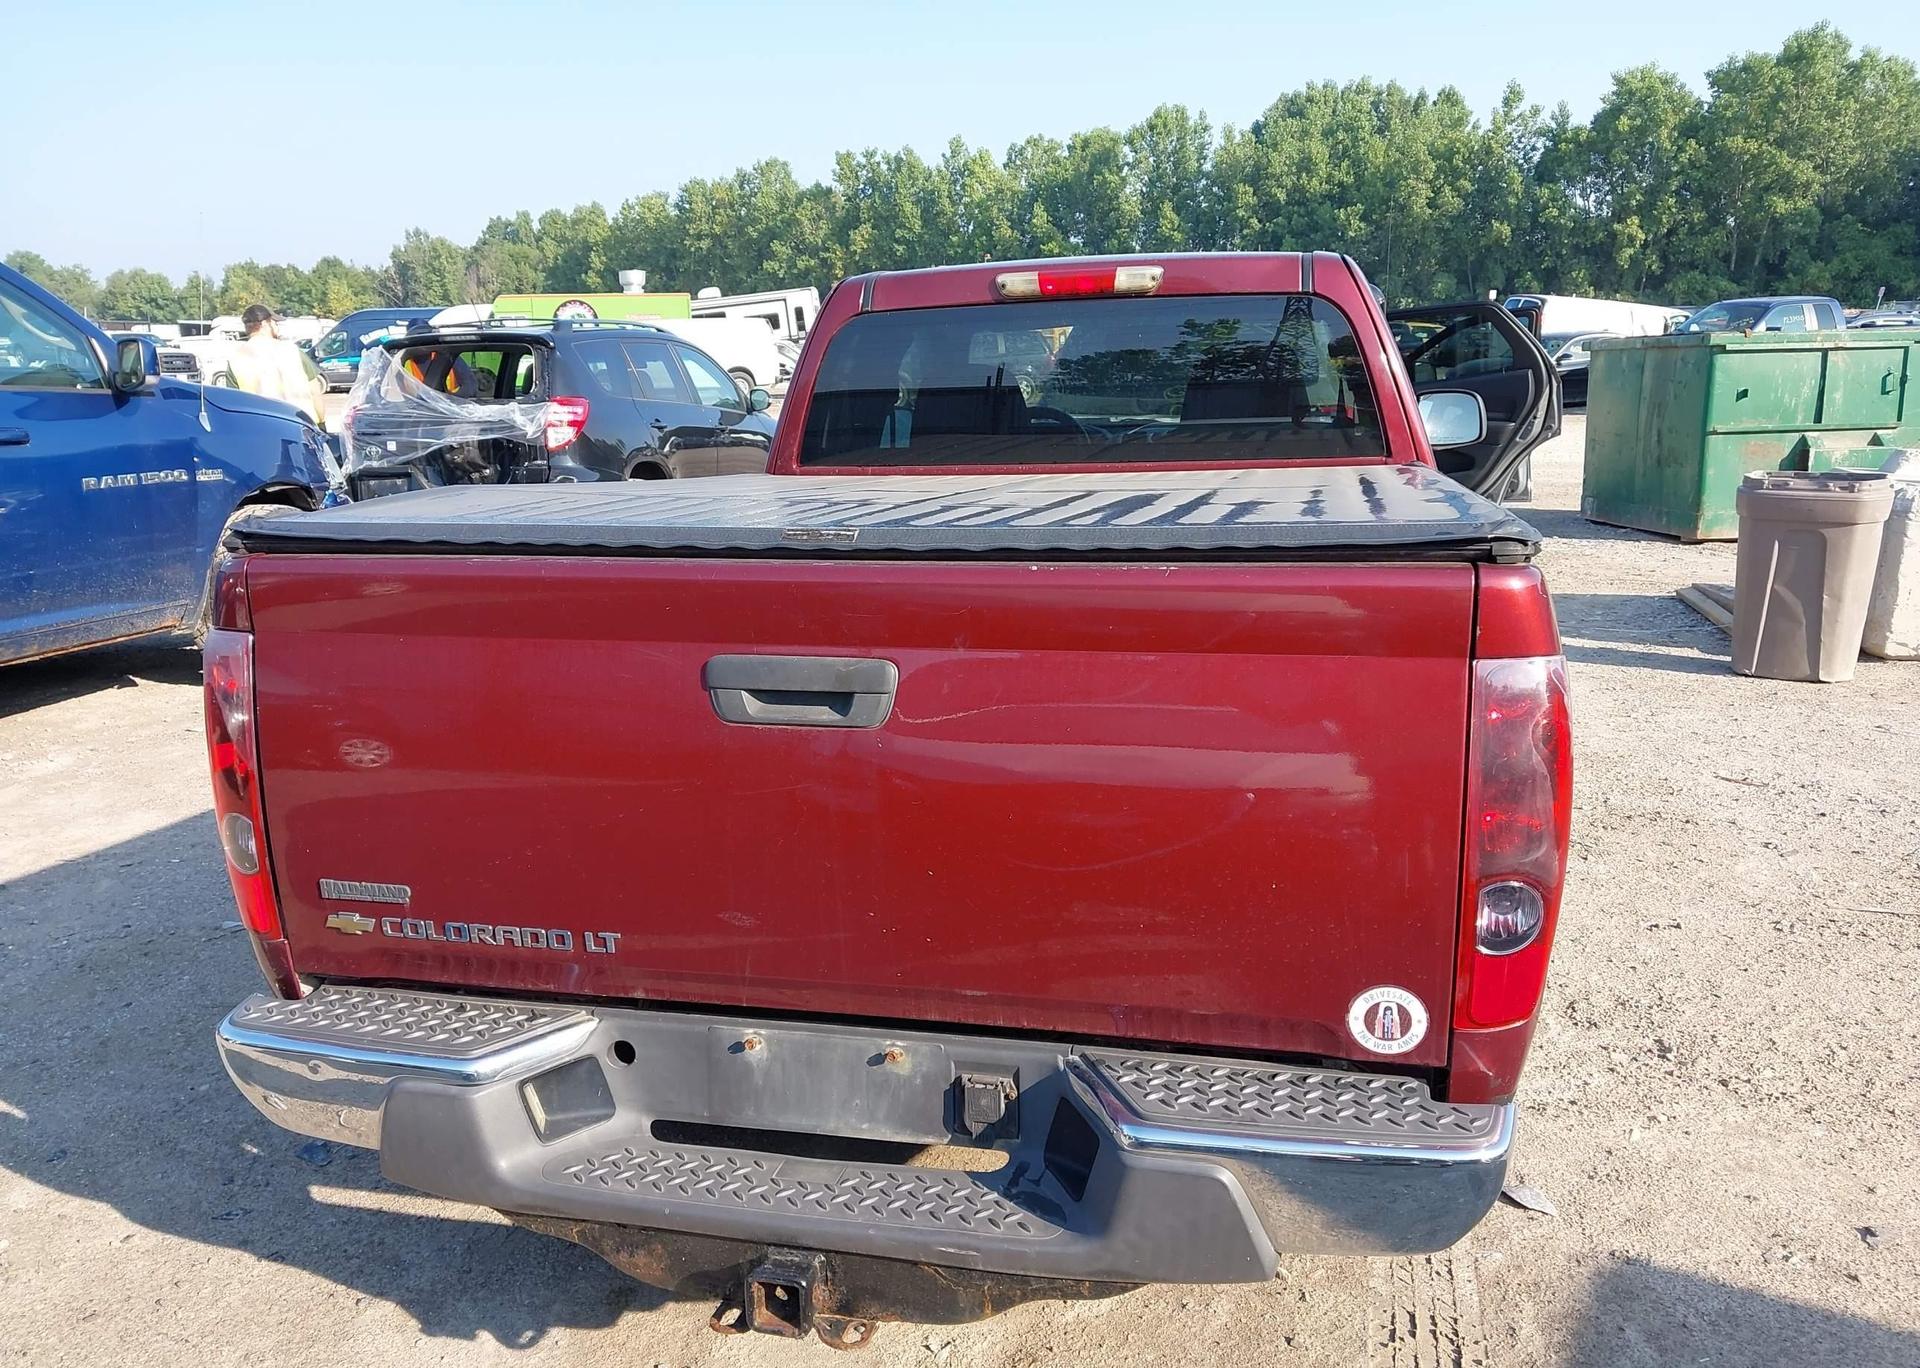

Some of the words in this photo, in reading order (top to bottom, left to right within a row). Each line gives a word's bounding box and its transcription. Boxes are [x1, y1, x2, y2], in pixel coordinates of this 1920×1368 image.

[82, 473, 138, 490] RAM
[140, 469, 188, 485] 1500
[381, 917, 573, 951] COLORADO
[584, 931, 620, 953] LT
[1373, 1041, 1393, 1051] WAR
